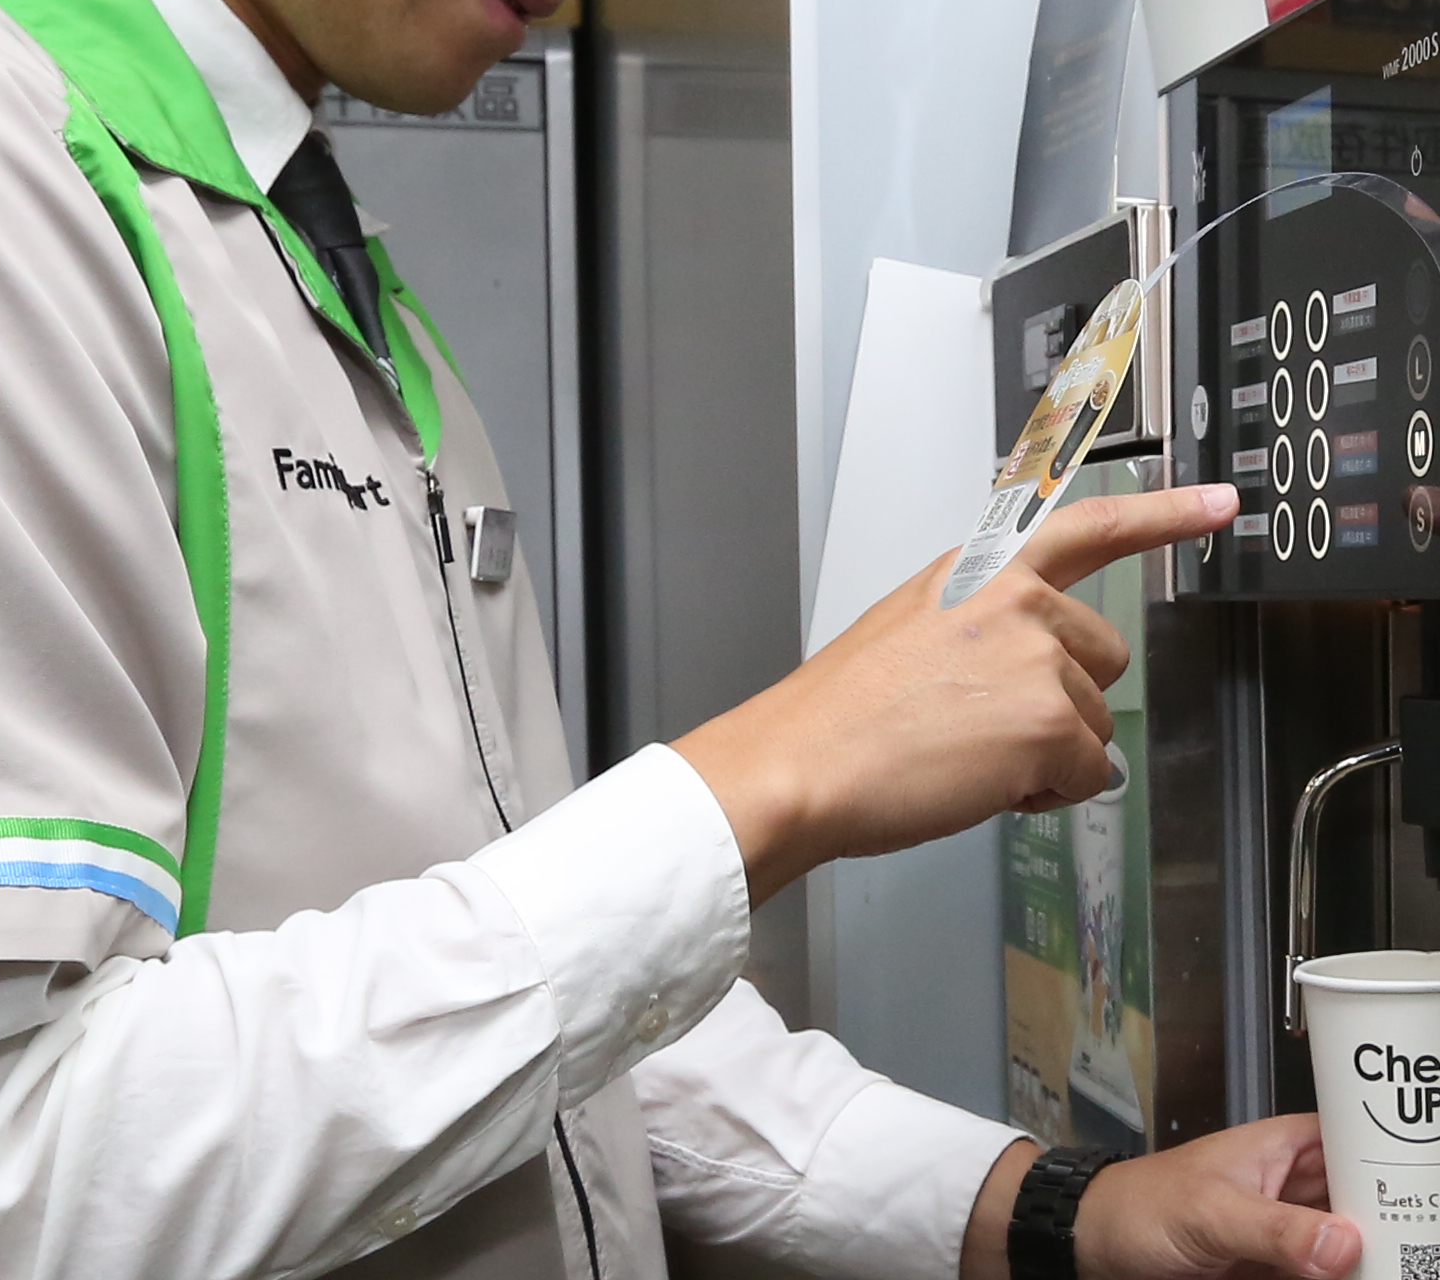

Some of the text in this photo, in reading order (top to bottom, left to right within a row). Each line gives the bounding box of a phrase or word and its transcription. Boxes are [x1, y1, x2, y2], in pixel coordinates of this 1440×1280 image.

[1415, 356, 1424, 380] L
[1414, 430, 1426, 457] M
[1416, 507, 1425, 532] S
[1376, 1178, 1424, 1208] Let's
